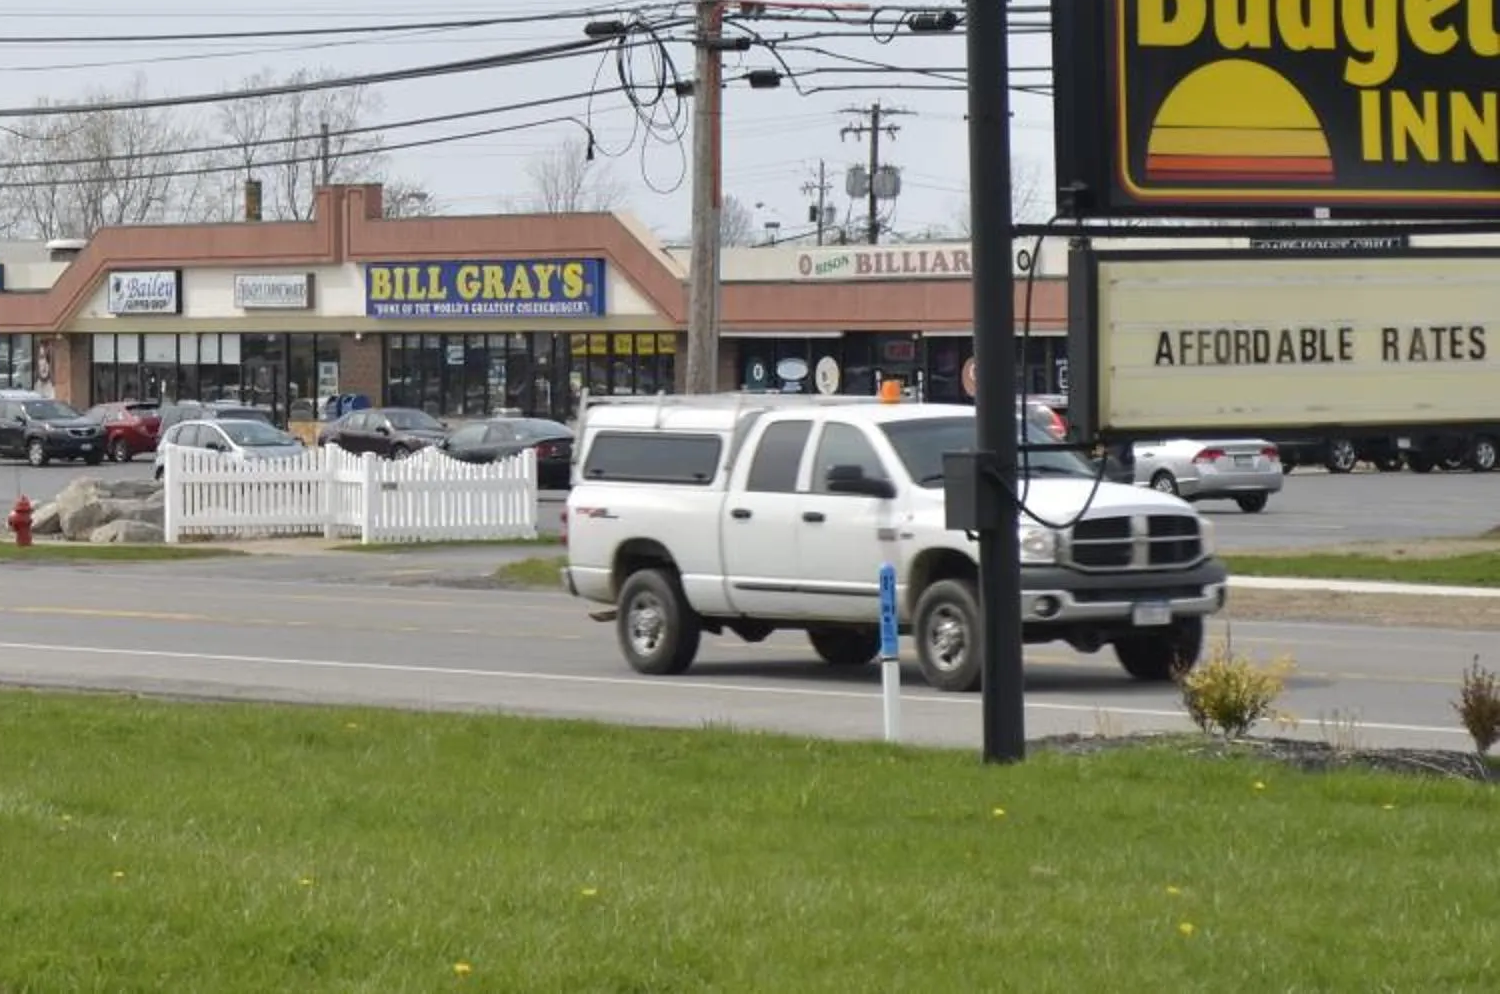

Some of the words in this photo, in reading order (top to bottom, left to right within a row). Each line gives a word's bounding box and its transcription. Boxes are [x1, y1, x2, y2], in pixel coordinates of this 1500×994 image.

[1360, 89, 1499, 163] INN
[370, 266, 447, 301] BILL
[456, 262, 584, 300] GRAY'S
[854, 251, 973, 275] BILLIAR
[123, 276, 174, 302] Bailey
[1154, 327, 1354, 366] AFFORDABLE
[1381, 325, 1487, 362] RATES
